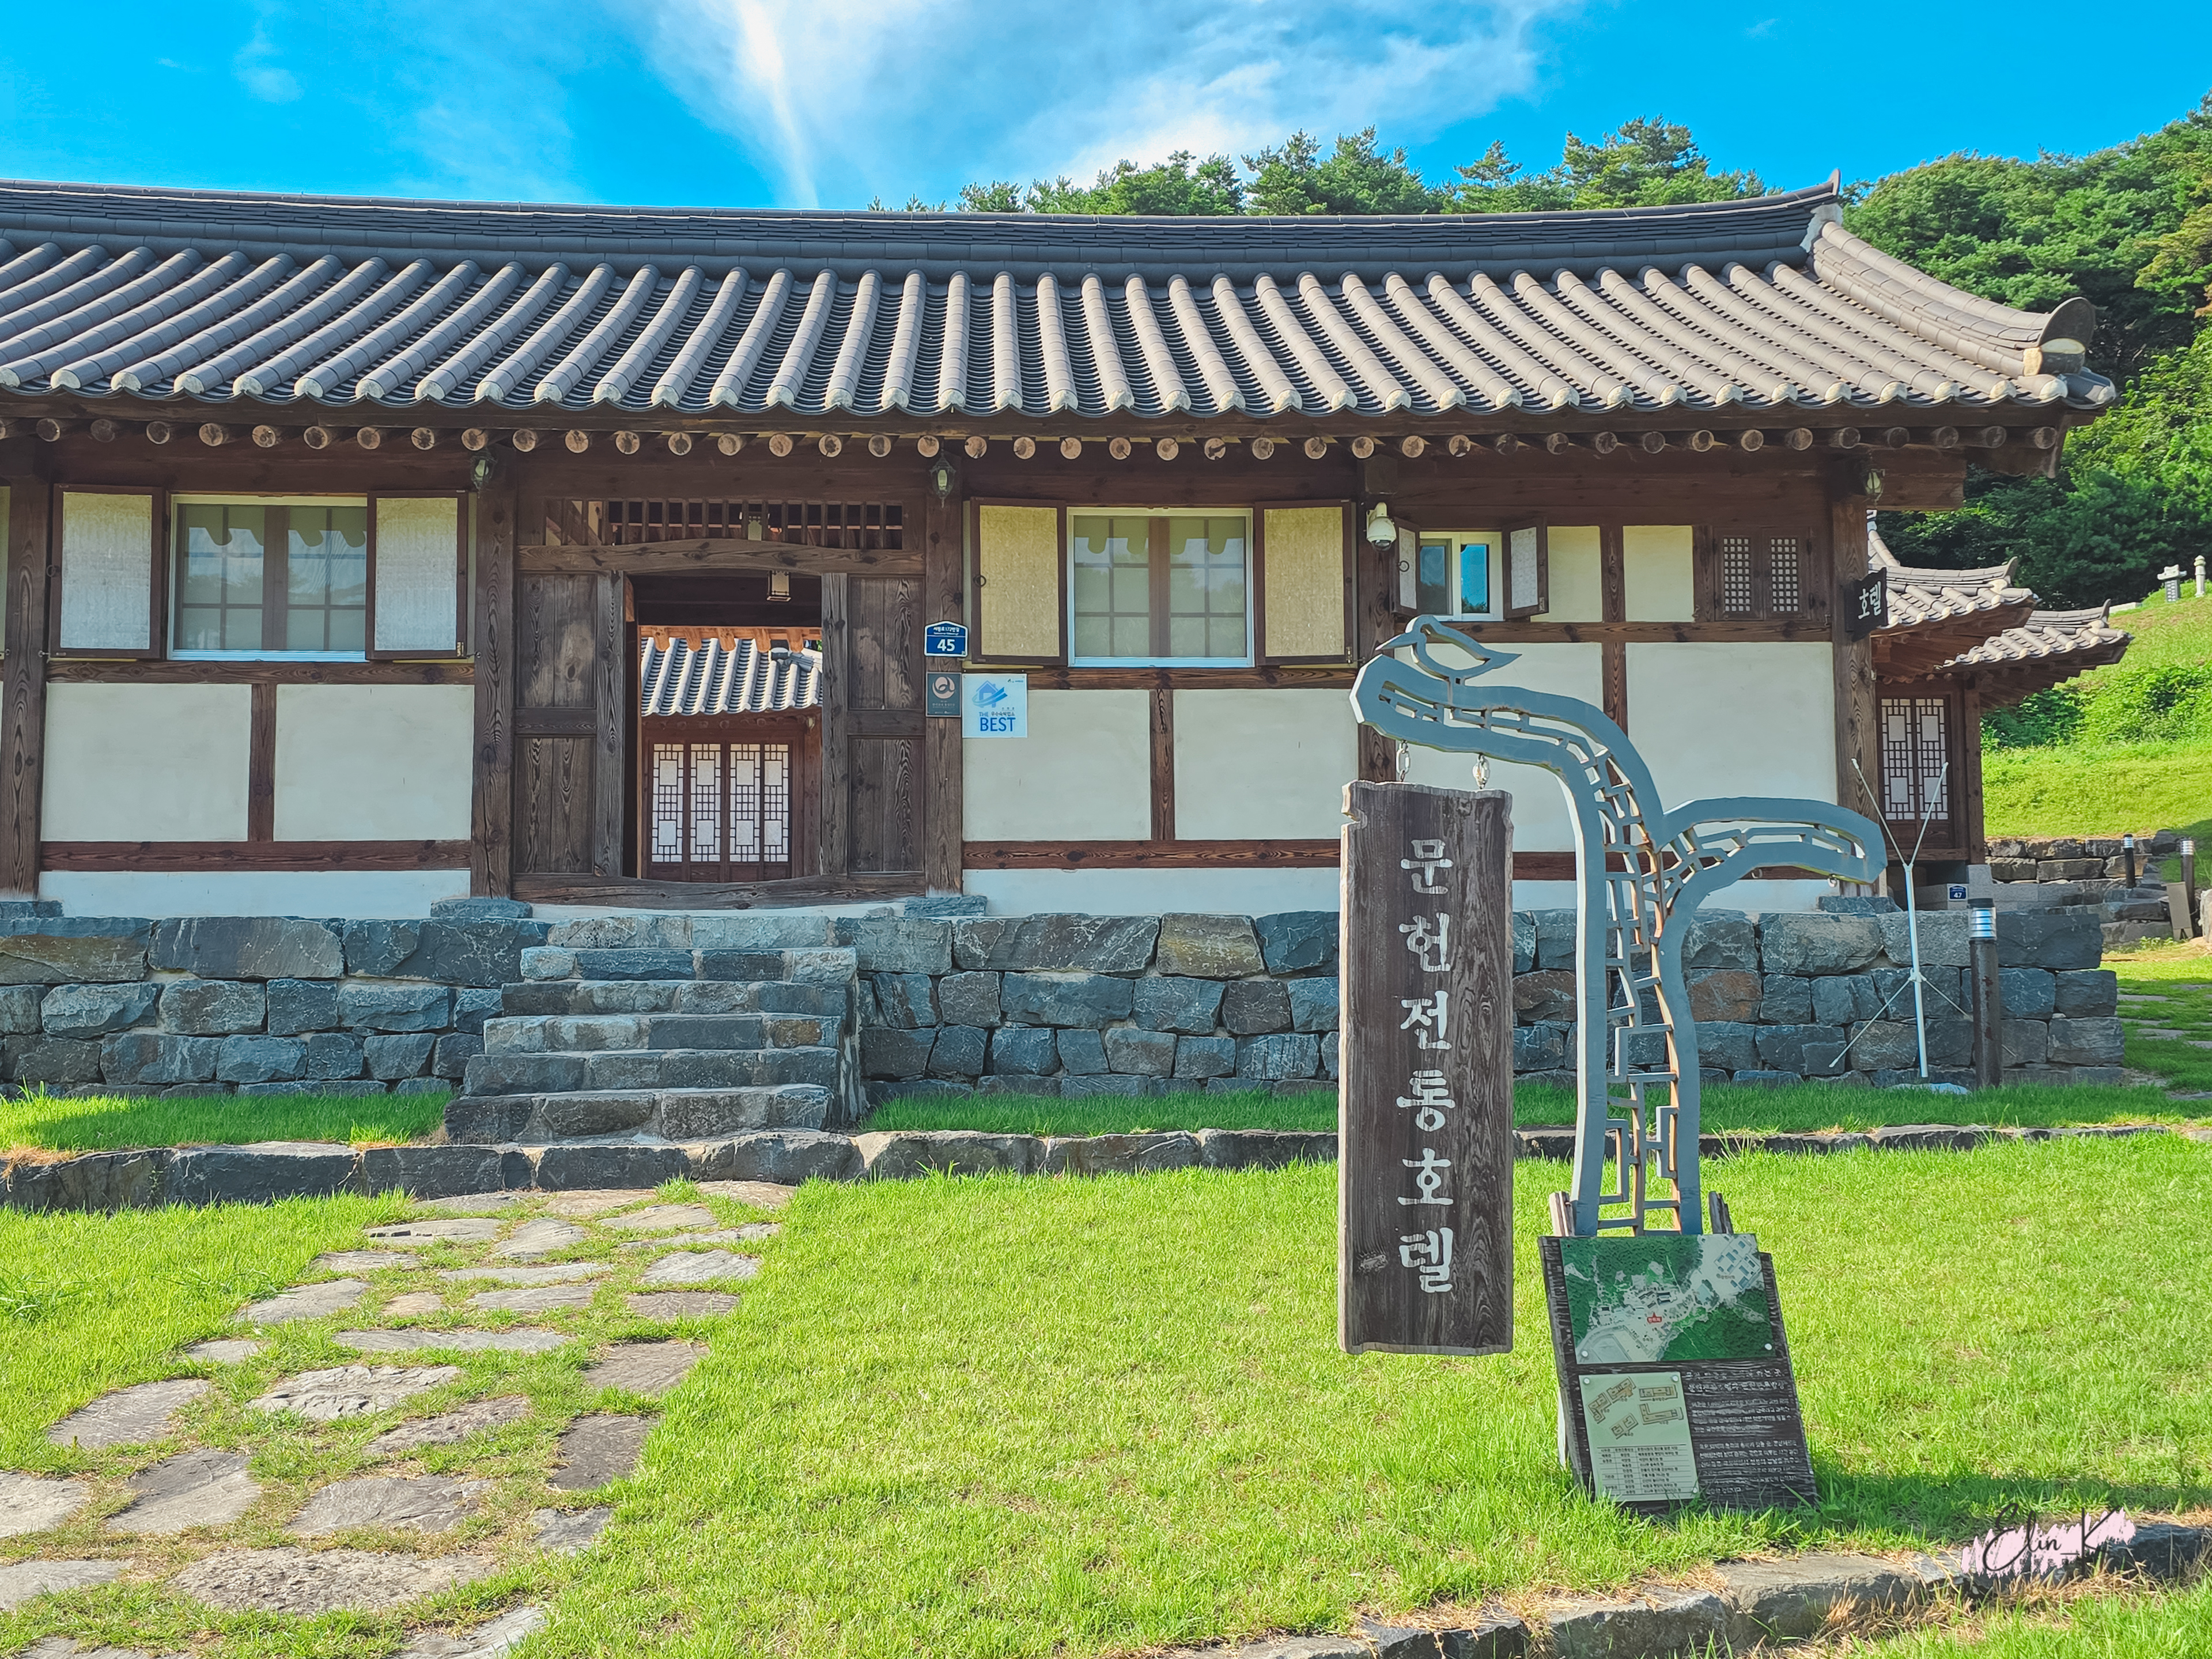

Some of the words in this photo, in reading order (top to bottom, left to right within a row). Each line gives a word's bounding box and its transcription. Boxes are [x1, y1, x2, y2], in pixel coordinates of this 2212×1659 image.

[1858, 580, 1882, 619] 호텔
[937, 638, 955, 652] 45
[980, 717, 1016, 732] BEST
